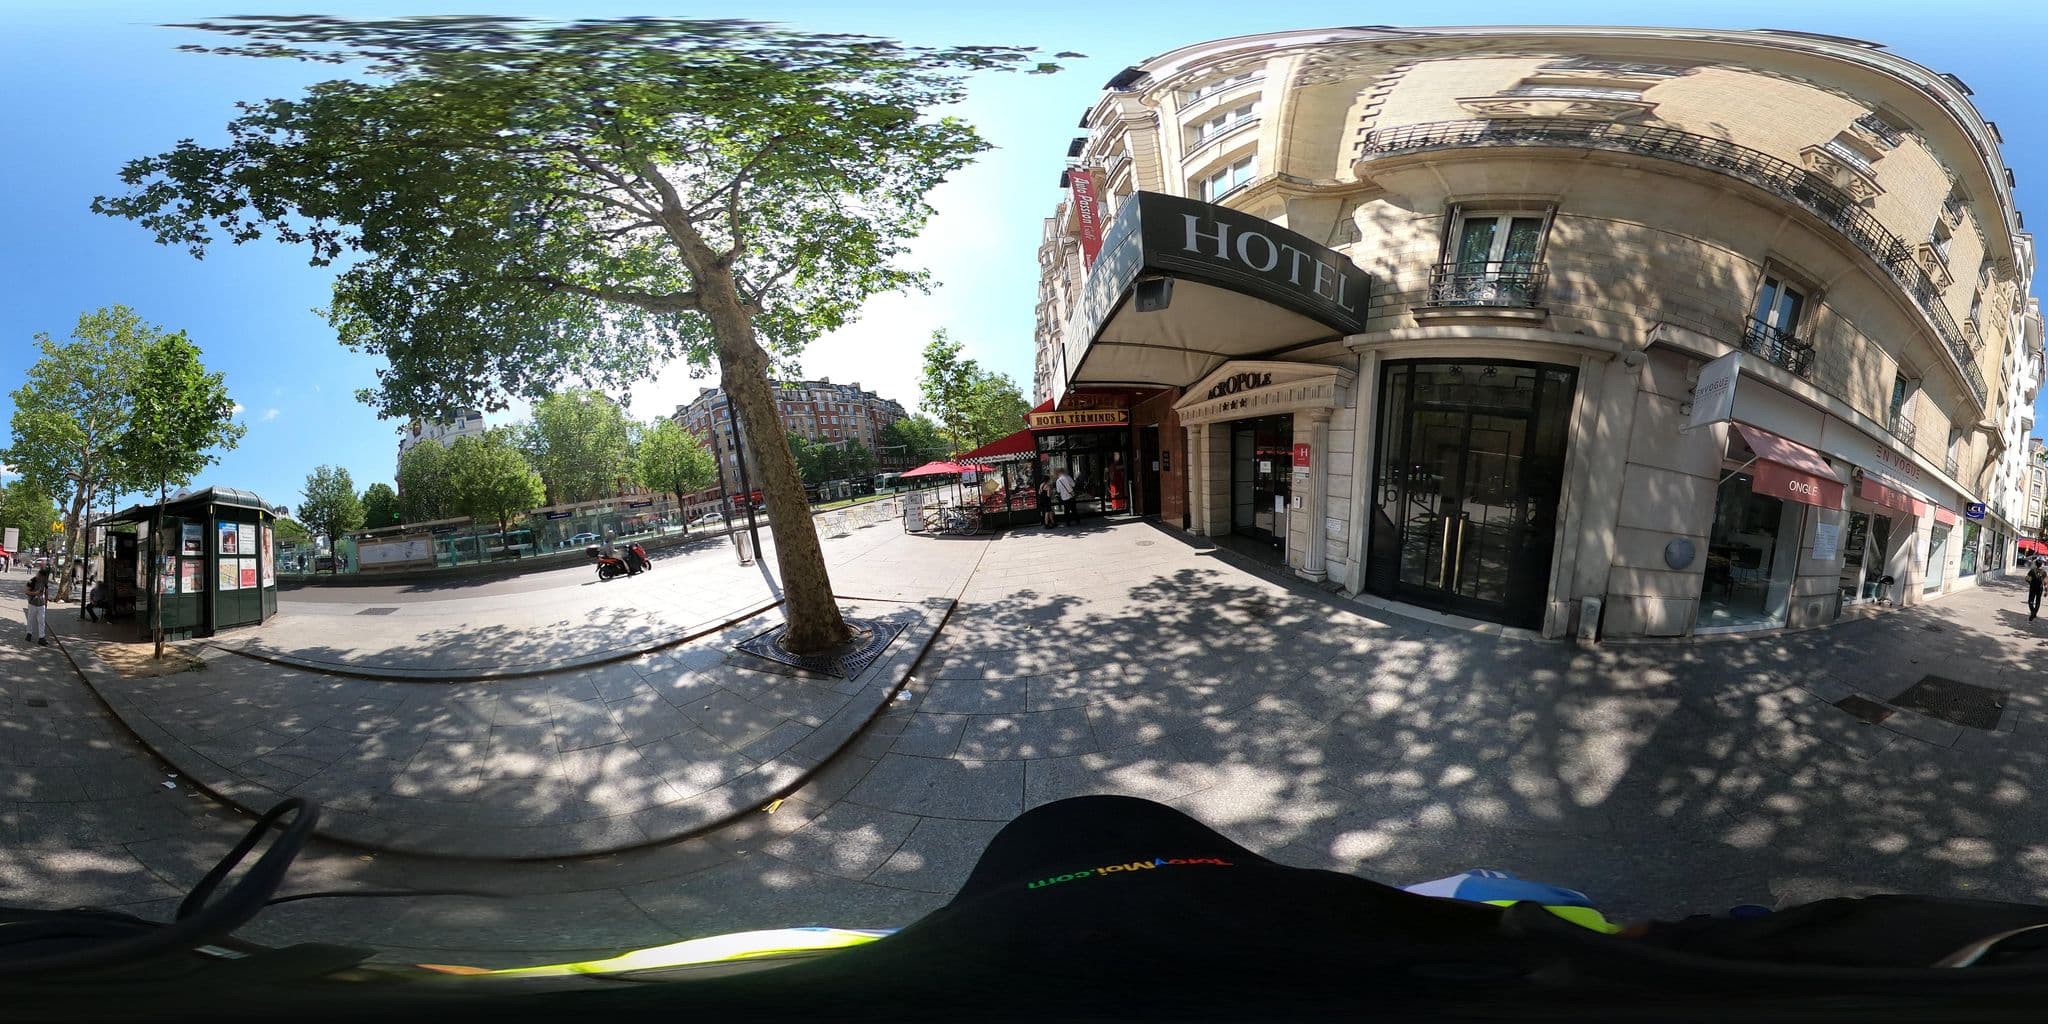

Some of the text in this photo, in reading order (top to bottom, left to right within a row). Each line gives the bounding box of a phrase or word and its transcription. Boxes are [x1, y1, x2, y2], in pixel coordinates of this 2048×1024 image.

[1078, 194, 1095, 224] Passion
[1179, 213, 1355, 313] HOTEL
[1207, 372, 1272, 400] ACROPOLE
[1036, 415, 1066, 425] HOTEL
[1300, 447, 1308, 457] H
[1894, 454, 1920, 480] VOGUE
[1789, 480, 1819, 497] ONGLE
[1967, 505, 1984, 513] LCL
